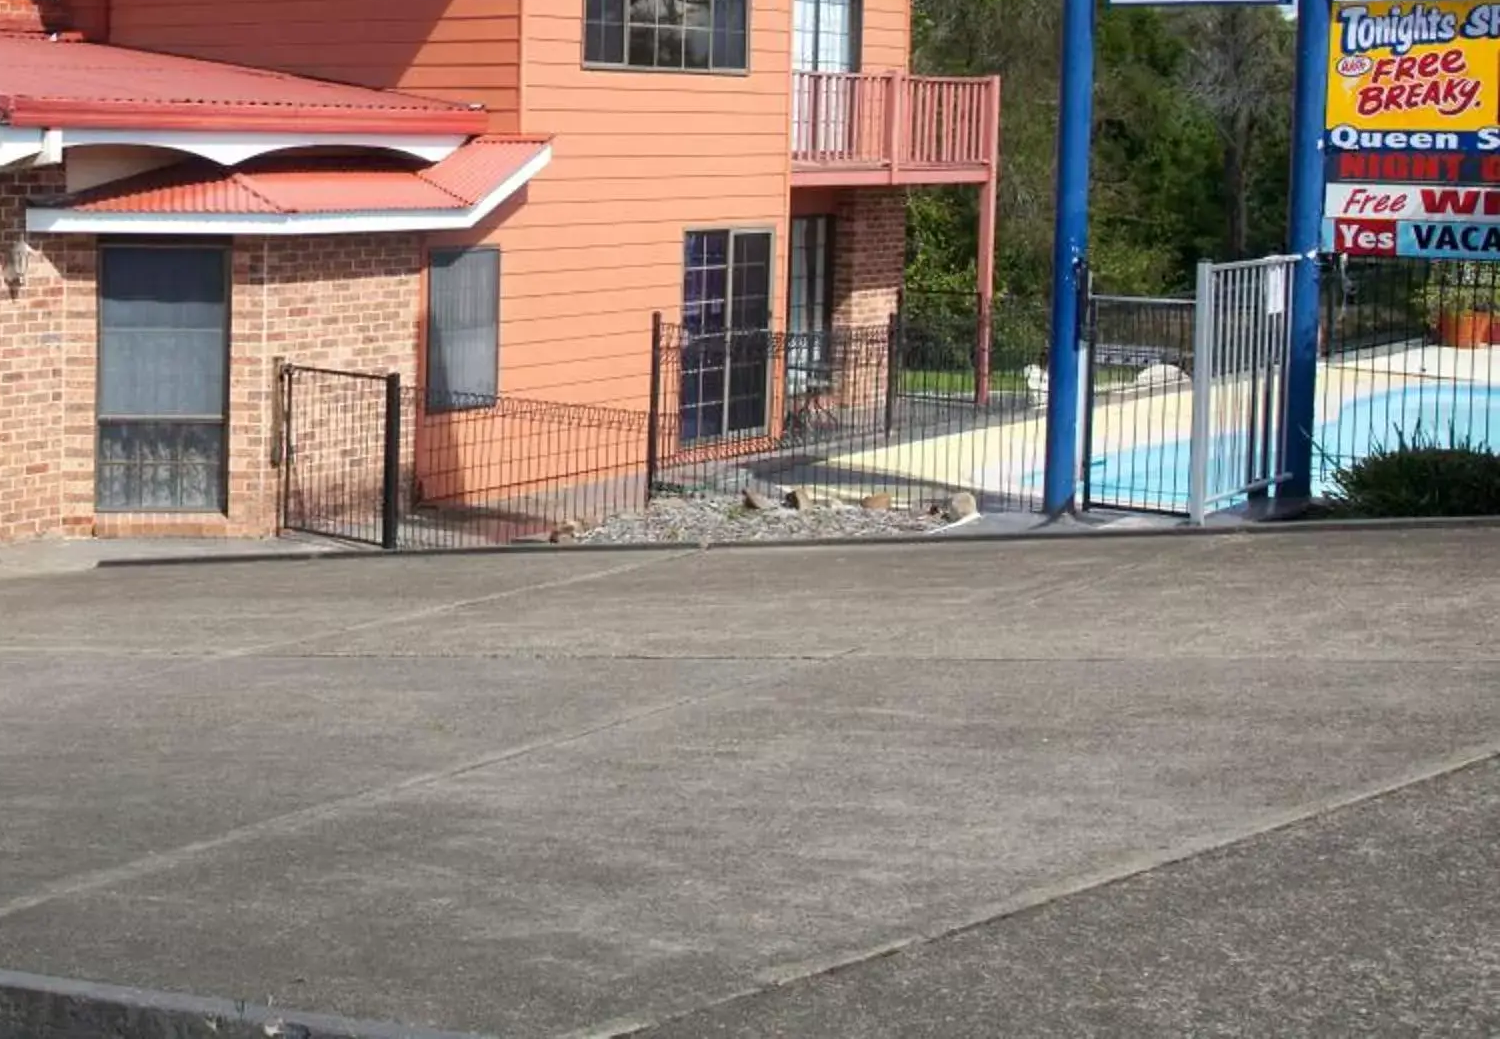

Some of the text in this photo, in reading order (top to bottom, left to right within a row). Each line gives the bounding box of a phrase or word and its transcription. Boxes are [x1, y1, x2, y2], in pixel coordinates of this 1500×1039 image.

[1338, 3, 1457, 53] Tonights
[1331, 126, 1458, 149] Queen
[1343, 188, 1407, 214] Free
[1339, 224, 1500, 251] Yes VACA
